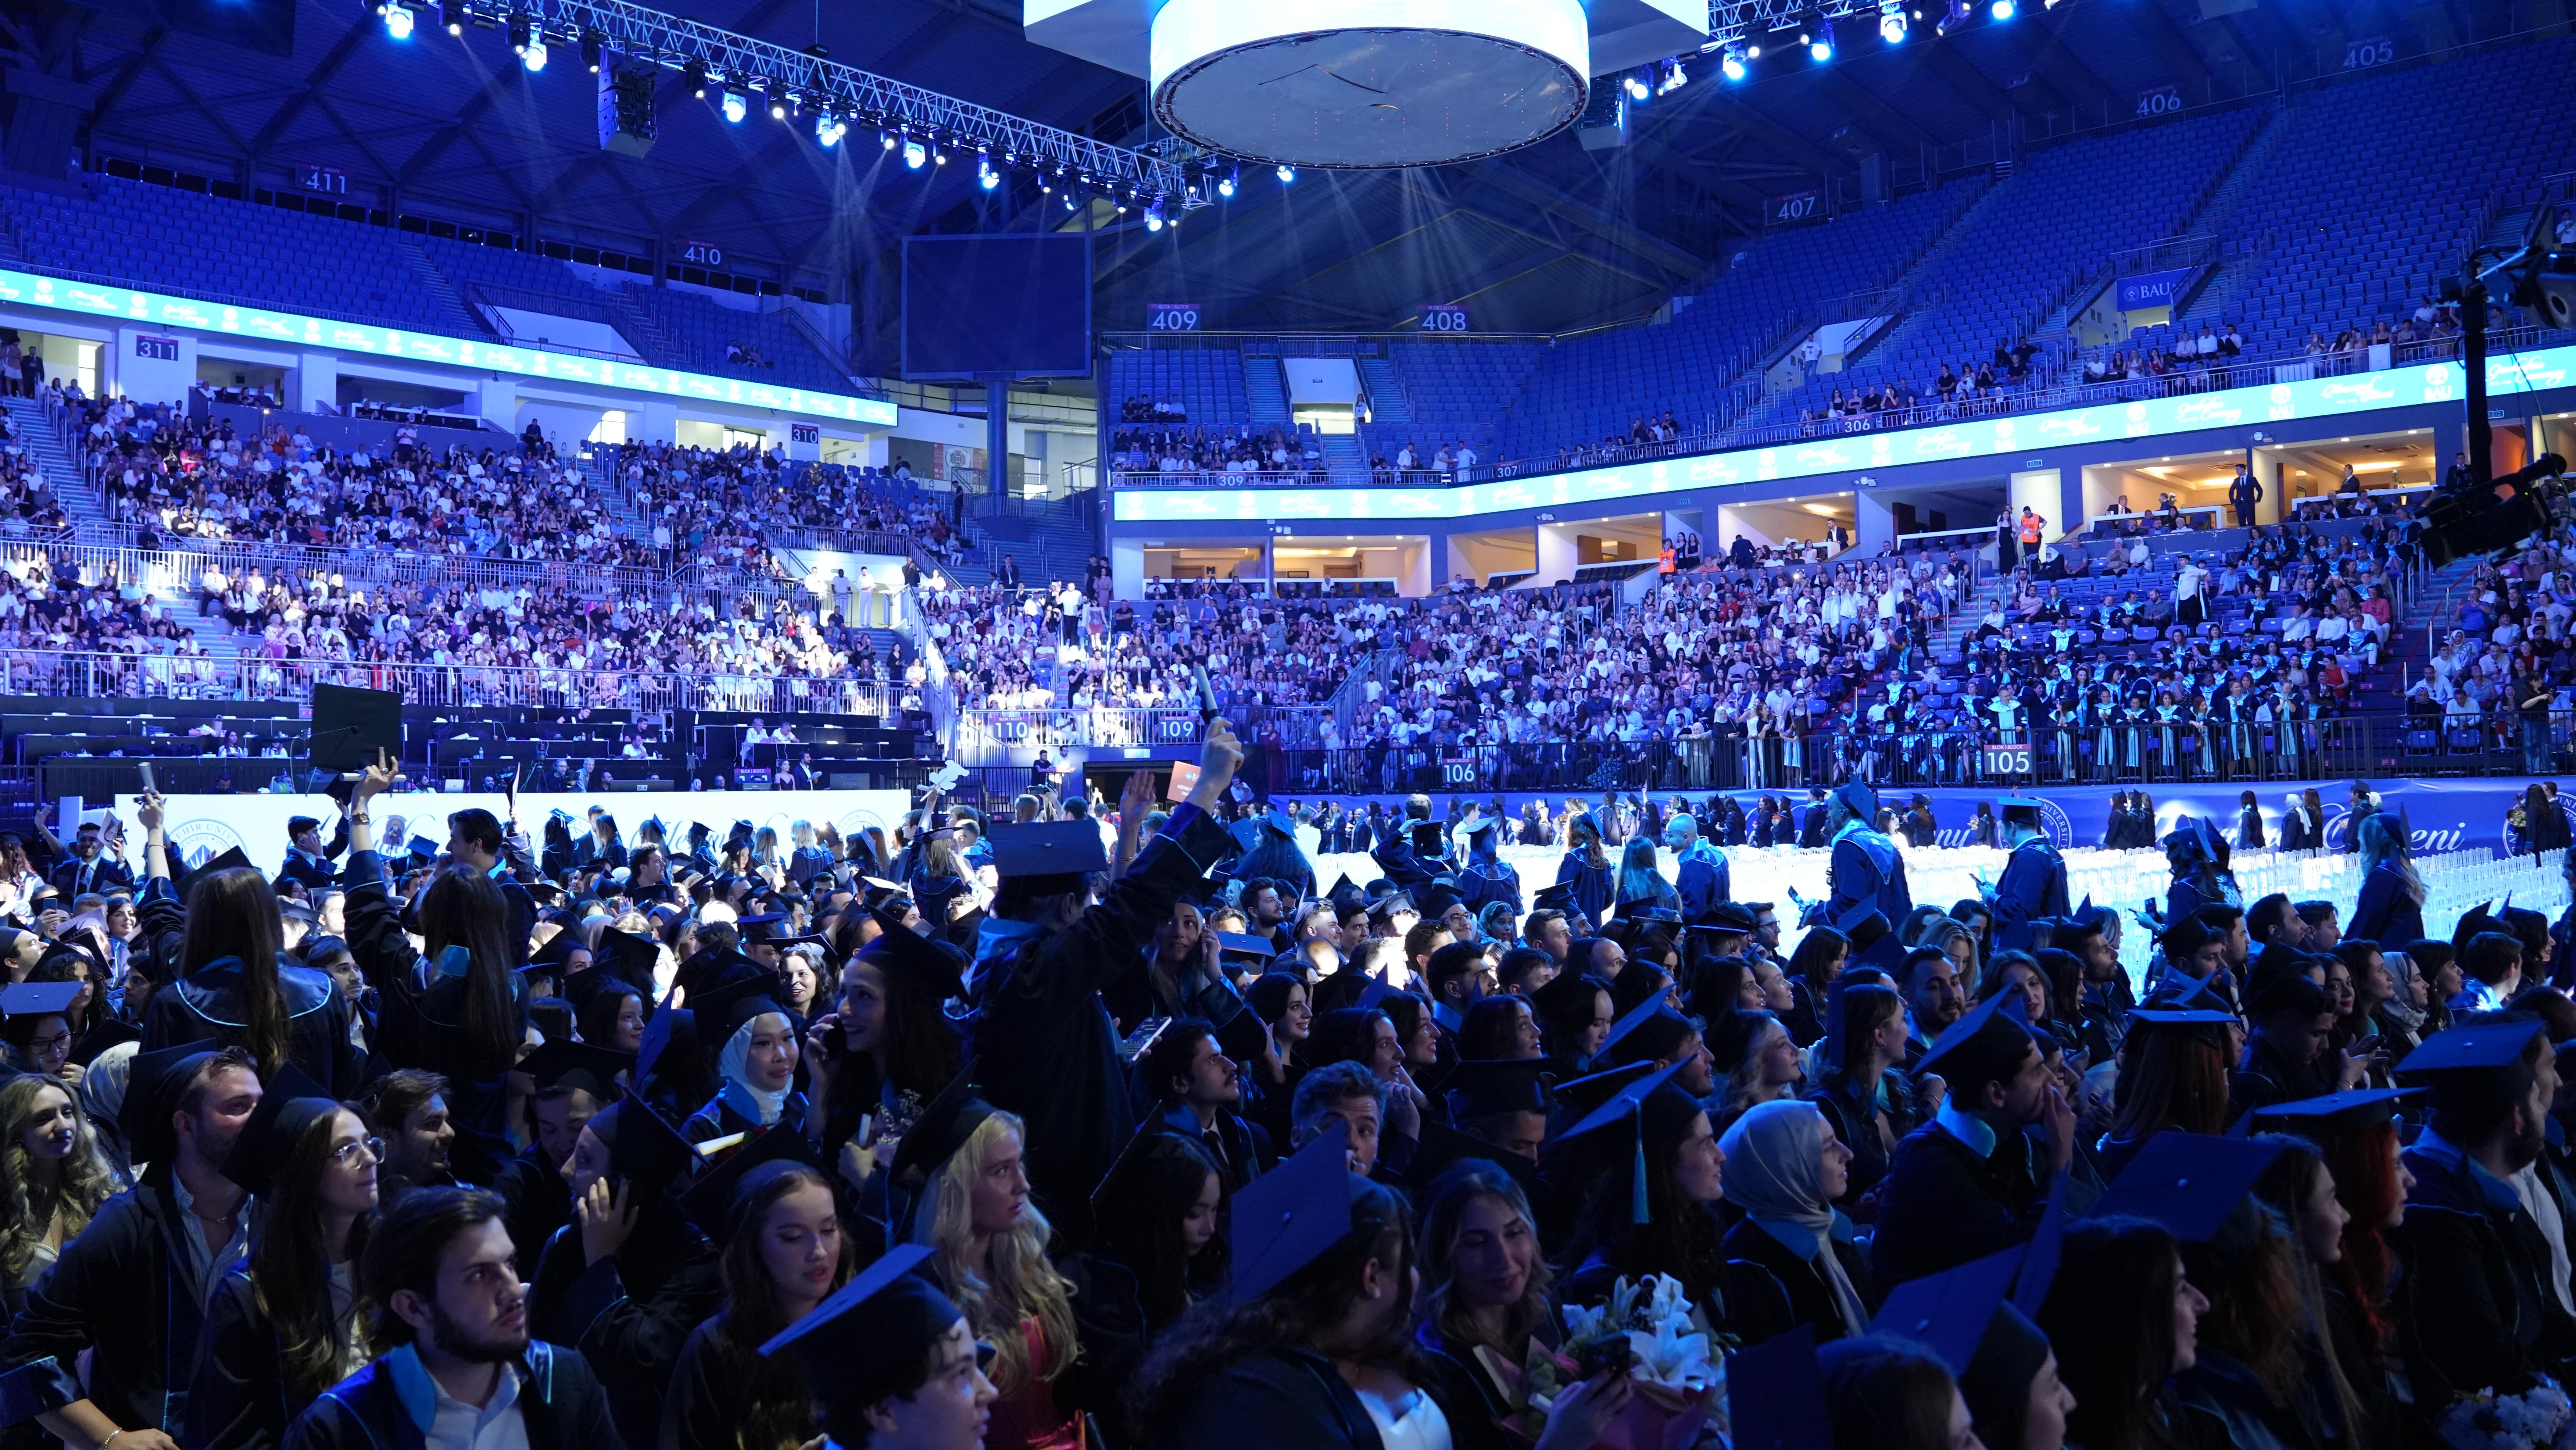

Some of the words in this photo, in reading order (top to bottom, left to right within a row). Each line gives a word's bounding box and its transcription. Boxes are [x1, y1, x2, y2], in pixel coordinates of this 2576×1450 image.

[2343, 41, 2393, 68] 405
[2136, 90, 2180, 115] 406
[306, 172, 345, 193] 411
[1778, 197, 1815, 219] 407
[684, 246, 720, 265] 410
[2140, 282, 2170, 298] BAU
[1152, 311, 1197, 330] 409
[1422, 312, 1466, 331] 408
[140, 342, 175, 360] 311
[1845, 419, 1870, 433] 306
[794, 429, 817, 443] 310
[1498, 465, 1517, 478] 307
[1219, 476, 1243, 486] 309
[995, 722, 1027, 738] 110
[1161, 721, 1194, 737] 109
[1987, 751, 2029, 773] 105
[1444, 764, 1474, 782] 106
[2040, 802, 2068, 849] NIVERSITY
[2043, 815, 2055, 826] 1998
